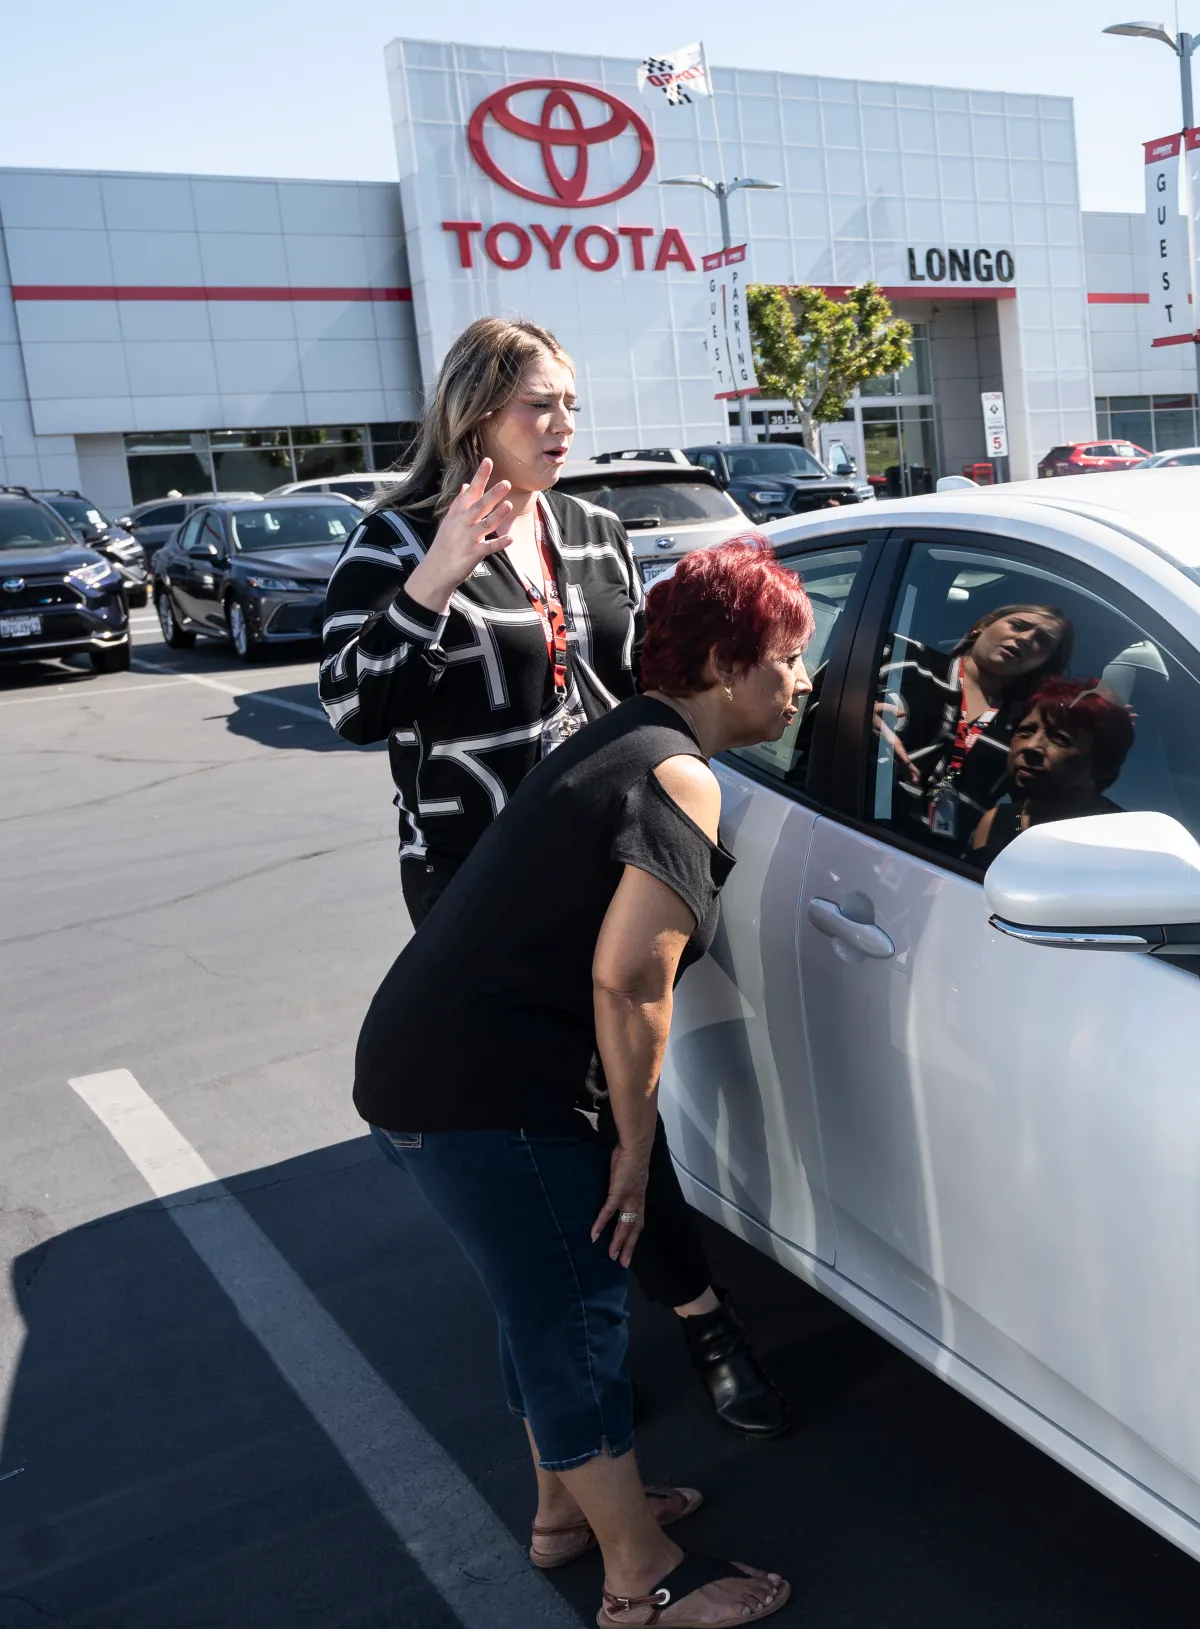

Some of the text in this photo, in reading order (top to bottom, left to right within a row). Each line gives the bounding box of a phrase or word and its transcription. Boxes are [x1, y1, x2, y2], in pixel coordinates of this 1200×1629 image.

[441, 221, 697, 272] TOYOTA
[907, 247, 1015, 282] LONGO
[1156, 173, 1173, 323] GUEST
[709, 279, 724, 383] GUEST
[732, 272, 748, 381] PARKING
[993, 437, 1001, 450] 5
